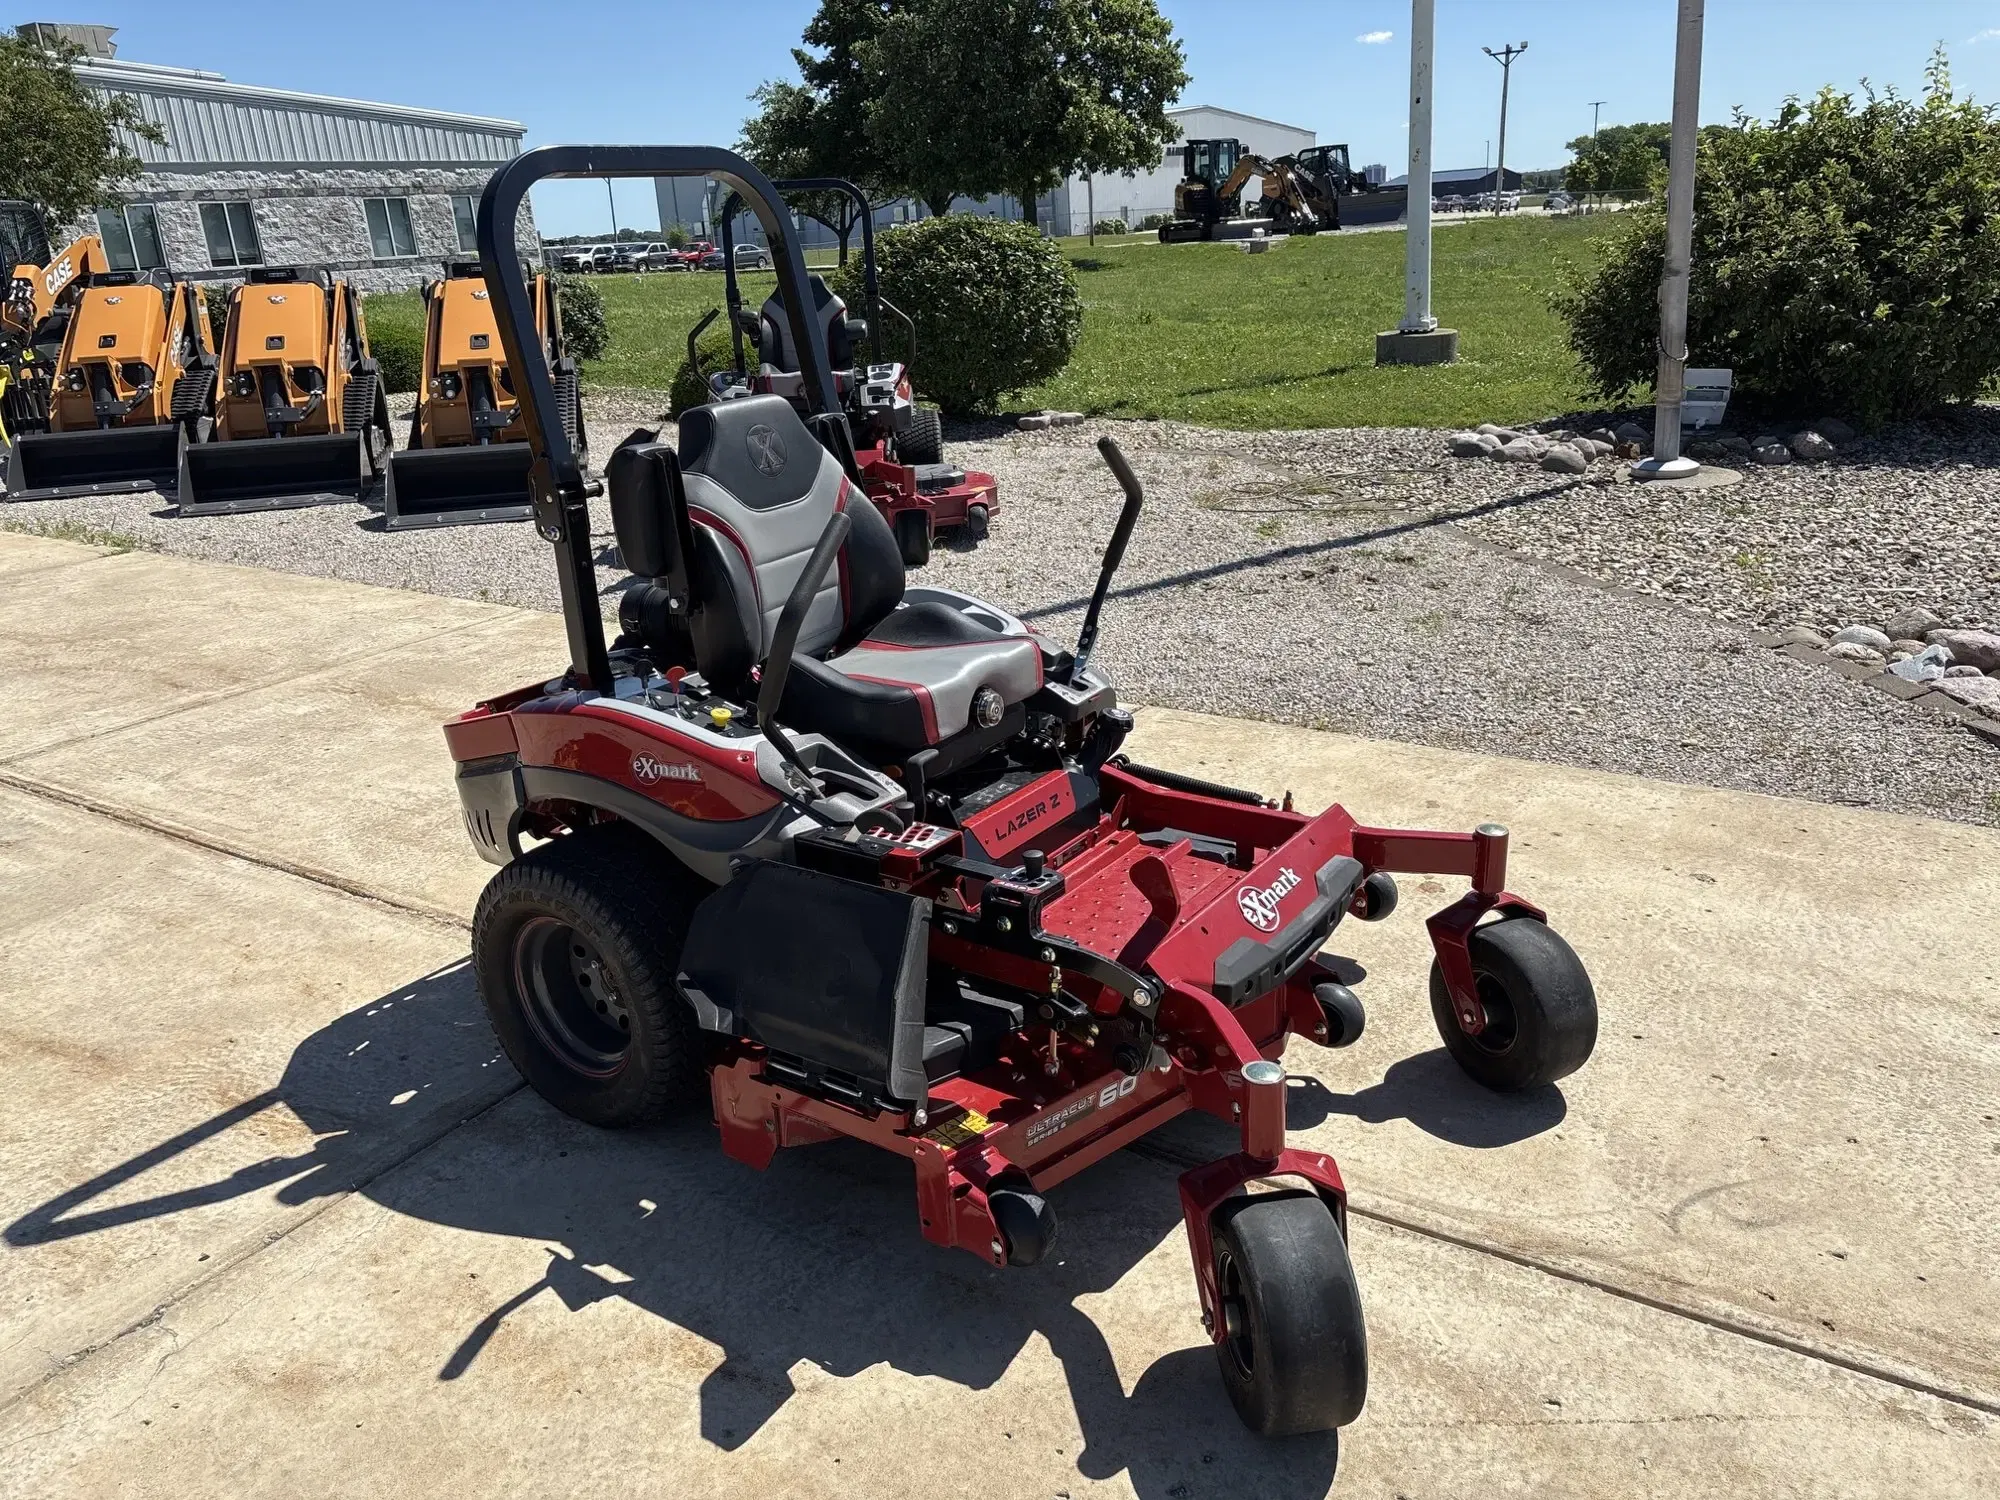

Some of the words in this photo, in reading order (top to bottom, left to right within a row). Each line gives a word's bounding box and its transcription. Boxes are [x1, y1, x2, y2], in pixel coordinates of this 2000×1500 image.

[1293, 163, 1316, 183] CASE
[45, 256, 74, 297] CASE
[632, 757, 702, 781] eXmark
[994, 801, 1048, 841] LAZER
[1049, 793, 1062, 809] Z
[1240, 866, 1303, 928] eXmark
[1026, 1093, 1097, 1138] ULTRACUT
[1098, 1074, 1138, 1109] 60
